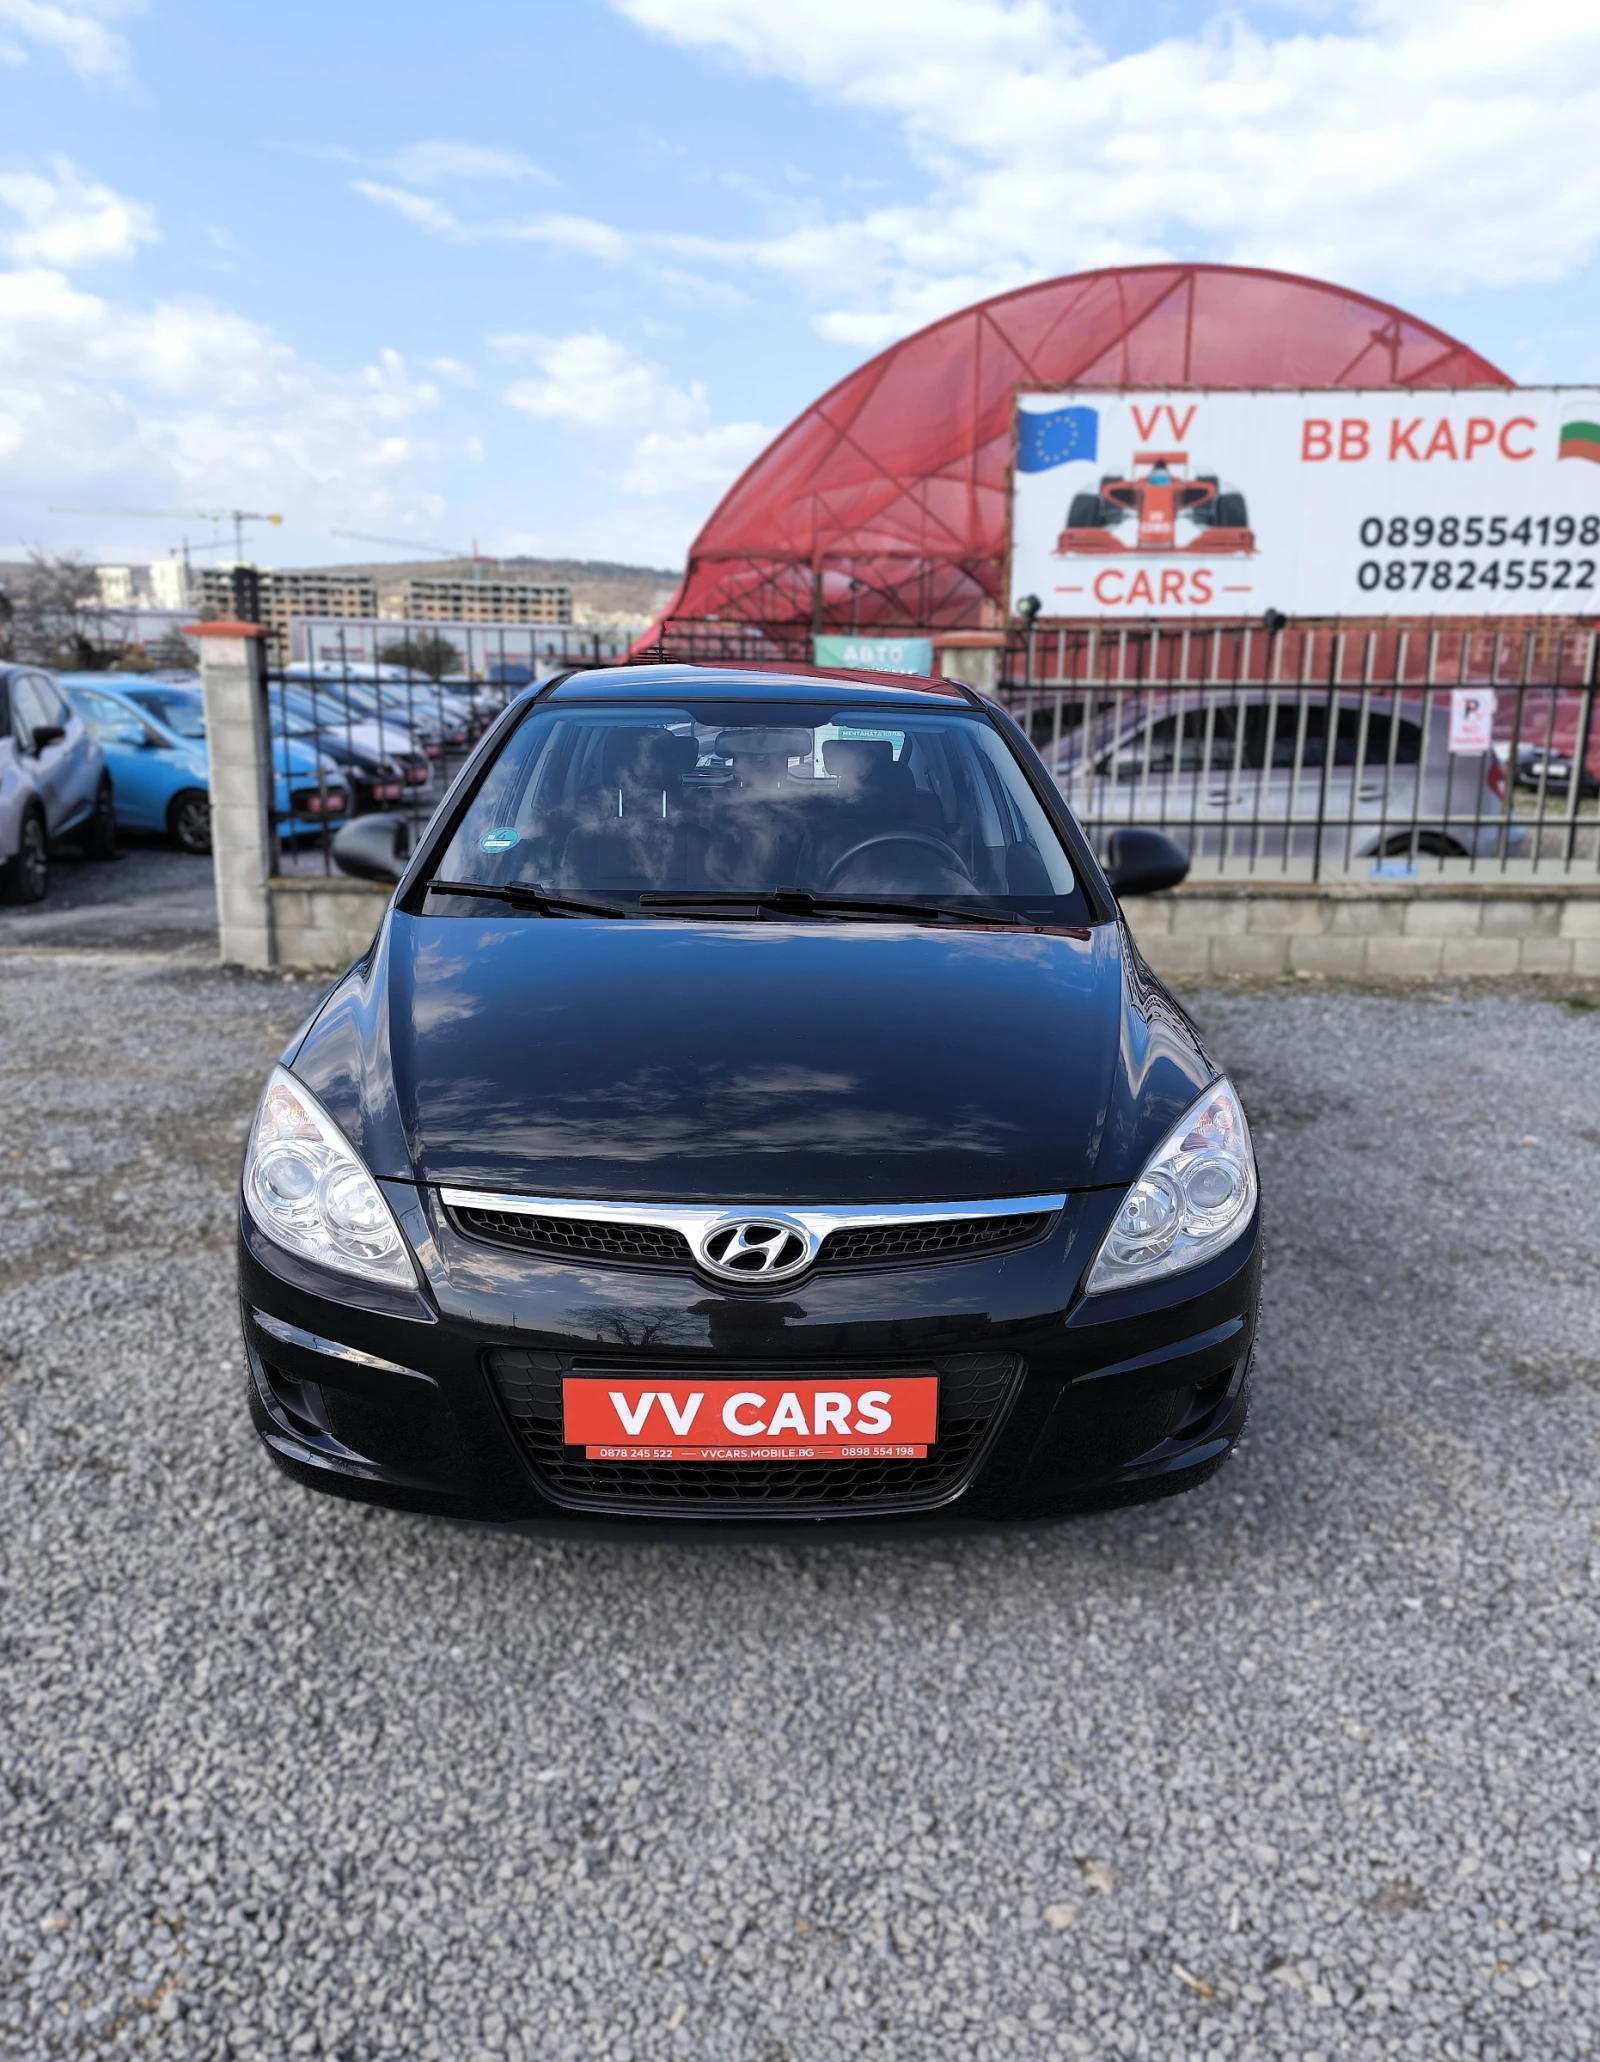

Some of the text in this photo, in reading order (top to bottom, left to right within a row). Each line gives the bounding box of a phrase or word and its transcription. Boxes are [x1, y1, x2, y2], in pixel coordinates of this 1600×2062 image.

[1131, 405, 1196, 442] VV
[1301, 416, 1537, 462] ВВ КАРС
[1360, 516, 1600, 547] 0898554198
[1093, 569, 1213, 605] CARS
[1357, 560, 1595, 591] 0878245522
[843, 645, 904, 665] АВТО
[608, 1390, 892, 1436] VV CARS
[600, 1447, 915, 1459] 0878 245 522 VVCARS.MOBILE.BG 0898 554 198
